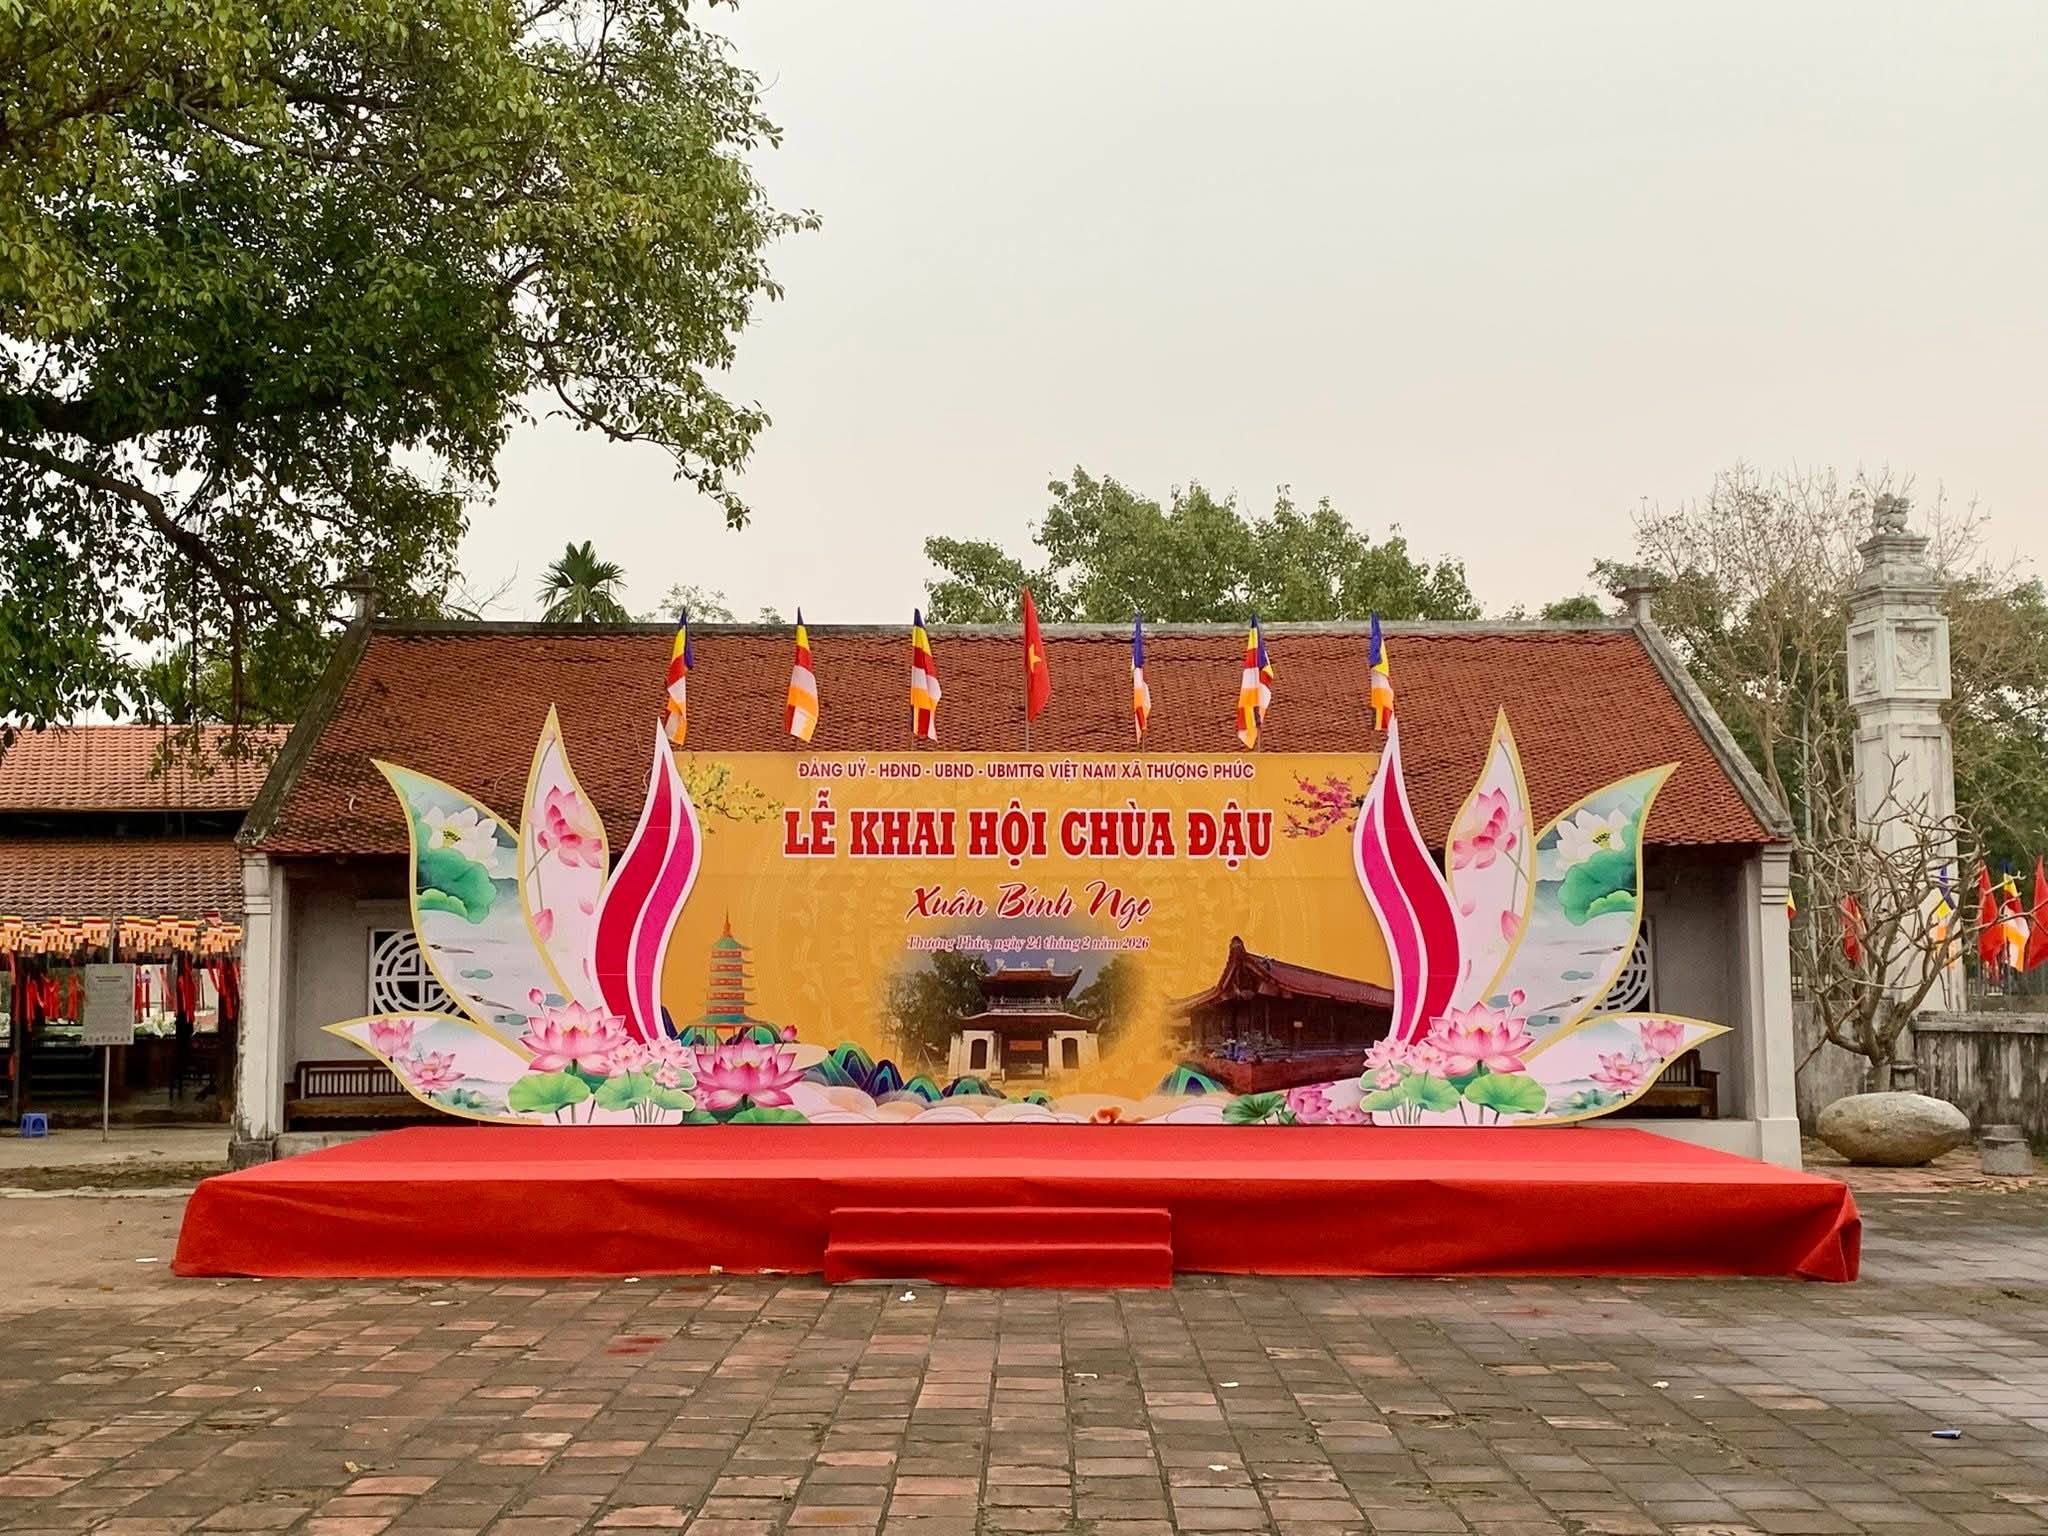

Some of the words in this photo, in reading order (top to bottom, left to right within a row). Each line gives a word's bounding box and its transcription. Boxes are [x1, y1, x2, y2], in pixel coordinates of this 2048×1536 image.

[799, 758, 842, 777] ĐẢNG
[879, 763, 921, 777] HĐND
[935, 763, 974, 777] UBND
[988, 763, 1045, 778] UBMTTQ
[1050, 760, 1078, 782] VIỆT
[1083, 764, 1116, 778] NAM
[1121, 761, 1142, 778] XÃ
[1147, 763, 1208, 783] THƯỢNG
[1213, 760, 1254, 778] PHÚC
[785, 789, 836, 855] LỄ
[849, 811, 956, 856] KHAI
[968, 800, 1047, 867] HỘI
[1061, 800, 1176, 856] CHÙA
[1187, 801, 1273, 867] ĐẬU
[905, 885, 986, 921] Xuân
[996, 882, 1075, 918] Bính
[1084, 880, 1152, 930] Ngọ
[1081, 936, 1090, 950] 2
[1120, 935, 1150, 951] 2026
